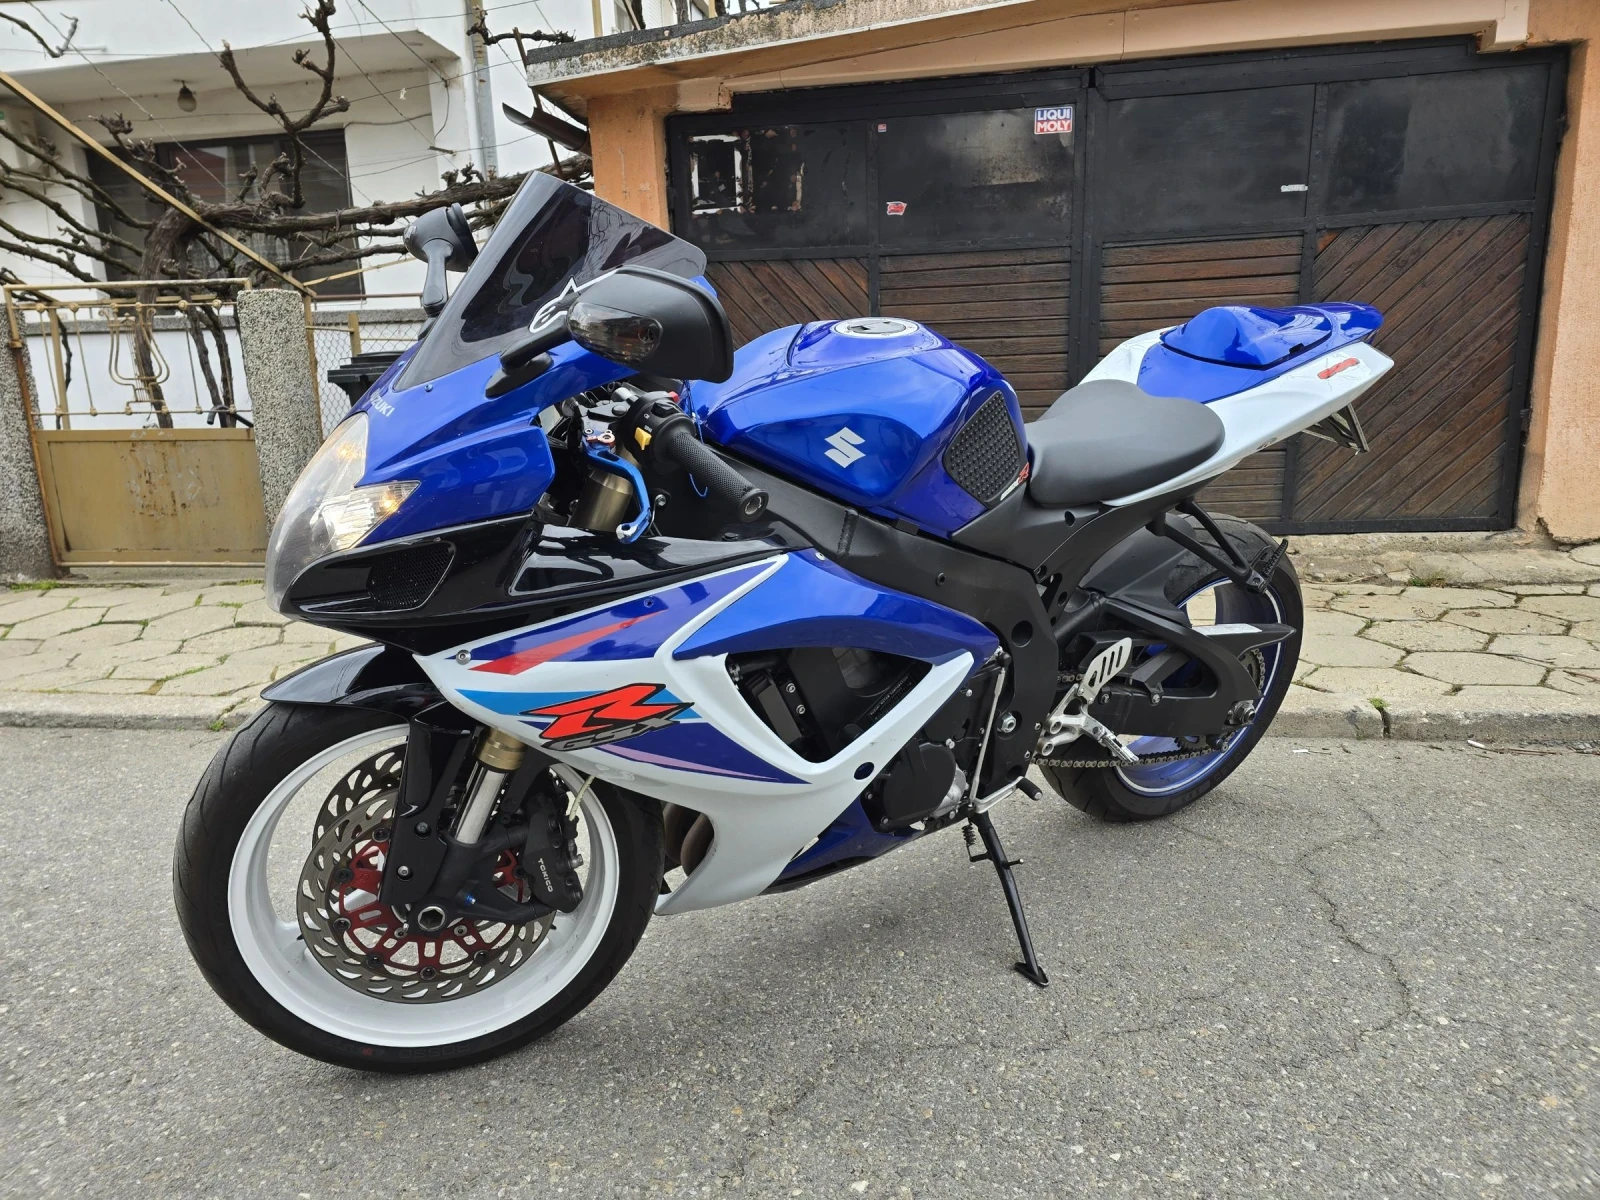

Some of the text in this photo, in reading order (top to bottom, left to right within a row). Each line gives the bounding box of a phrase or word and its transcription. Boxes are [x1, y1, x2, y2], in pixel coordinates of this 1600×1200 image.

[1037, 109, 1071, 120] LIQUI
[1036, 120, 1071, 132] MOLY
[370, 388, 395, 417] ZUKI
